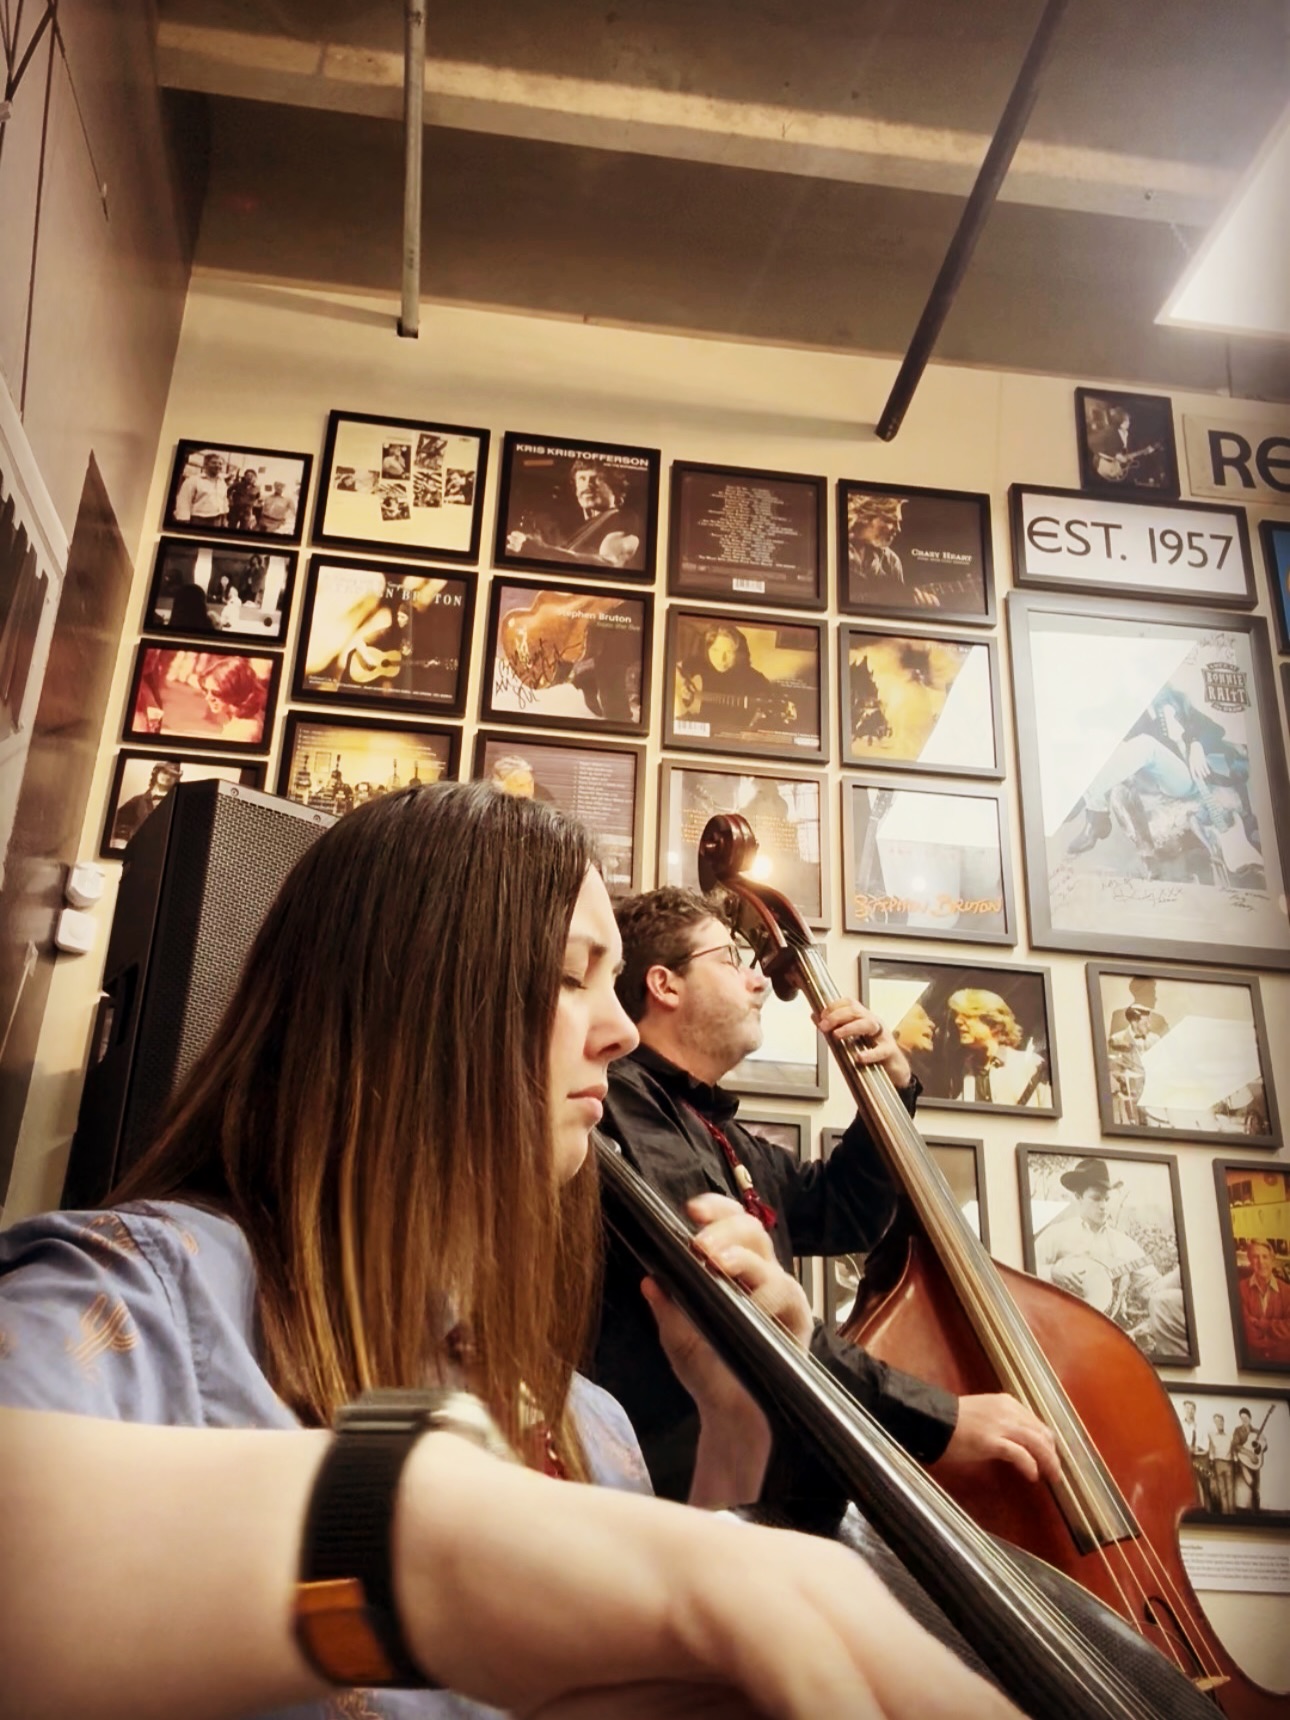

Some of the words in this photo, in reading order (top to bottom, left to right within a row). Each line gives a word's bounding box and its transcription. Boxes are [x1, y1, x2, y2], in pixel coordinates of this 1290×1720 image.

[516, 443, 545, 455] KRIS
[547, 447, 649, 467] KRISTOFFERSON
[1027, 516, 1127, 561] EST.
[1148, 527, 1234, 570] 1957
[402, 590, 462, 607] BRTON
[598, 612, 632, 624] Bruton
[1206, 672, 1243, 686] BONNIE
[1208, 686, 1245, 702] RAITT
